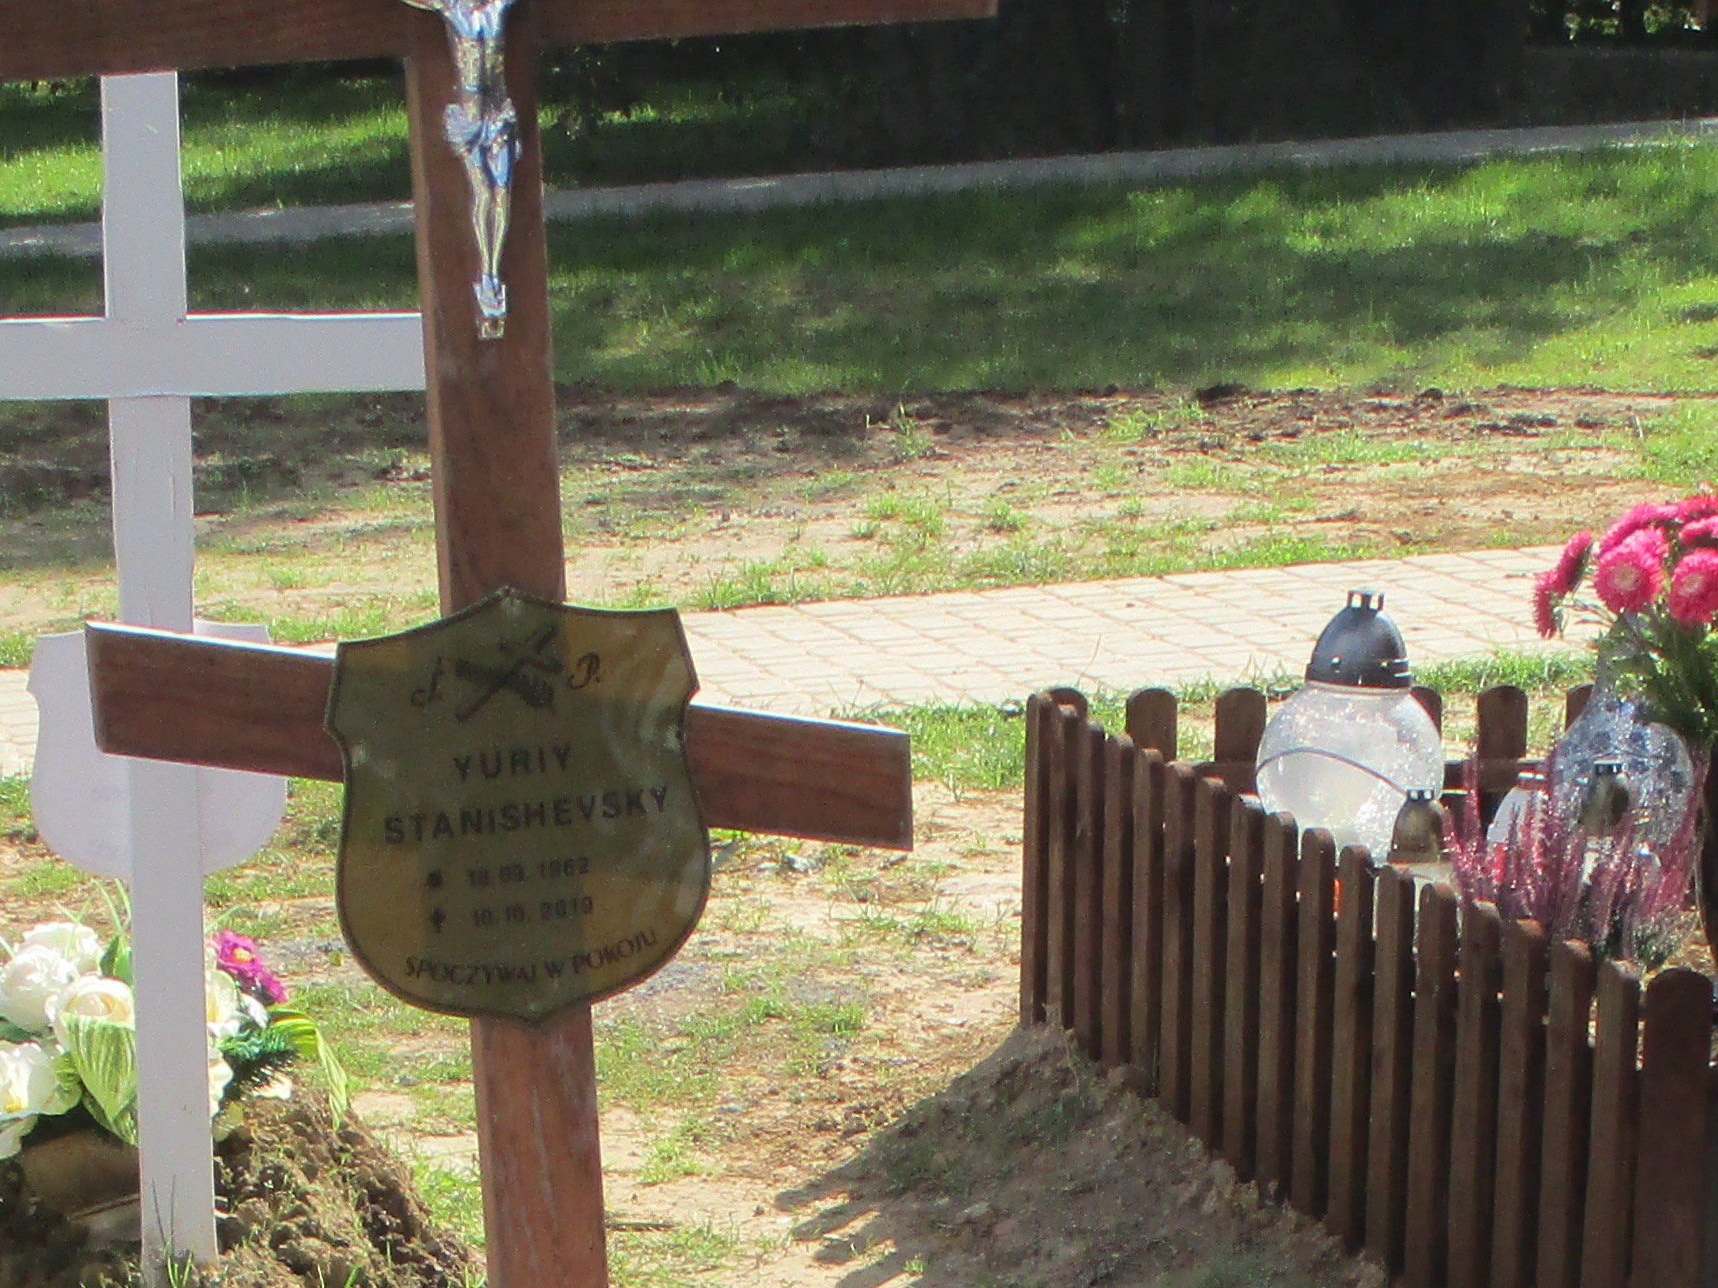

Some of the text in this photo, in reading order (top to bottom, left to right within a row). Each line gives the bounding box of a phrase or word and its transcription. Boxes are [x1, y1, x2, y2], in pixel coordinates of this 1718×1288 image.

[454, 743, 573, 780] YURIY
[384, 785, 670, 845] STANISHEVSKY
[404, 929, 660, 986] SPOCZYWAJ W POKOJU
